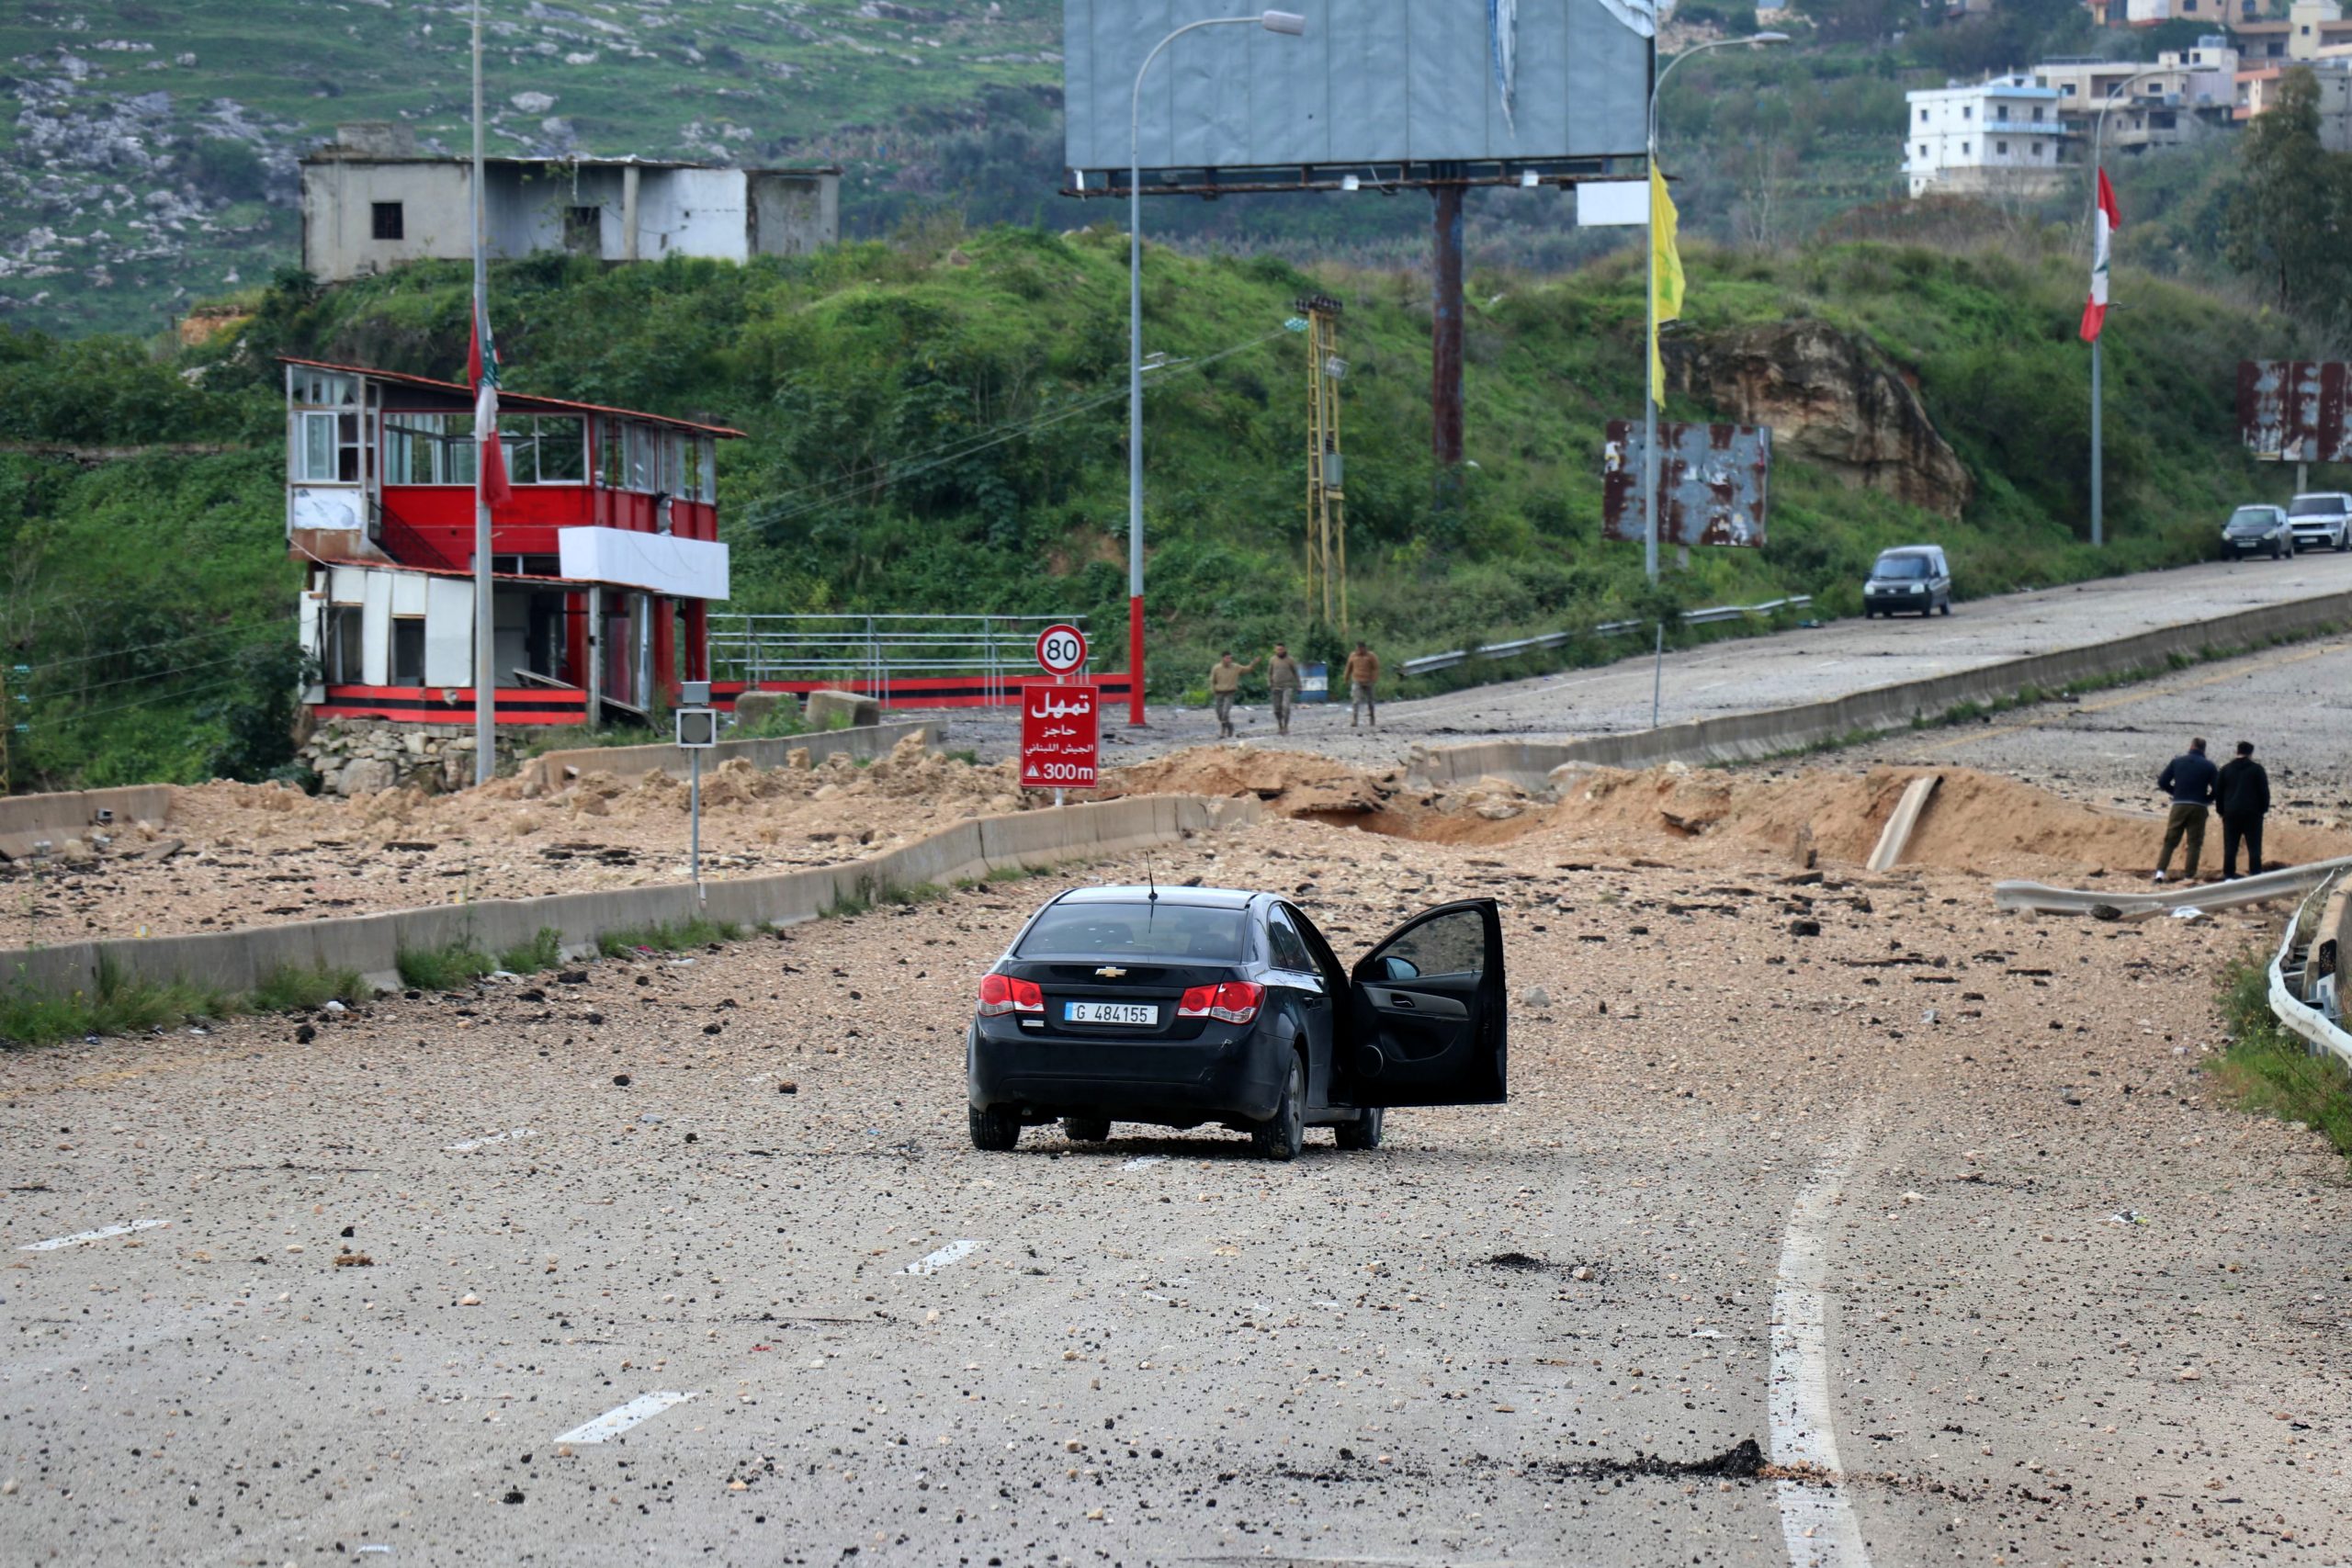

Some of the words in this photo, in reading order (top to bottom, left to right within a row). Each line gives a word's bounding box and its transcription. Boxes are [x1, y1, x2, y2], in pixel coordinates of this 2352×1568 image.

[1046, 639, 1078, 661] 80
[1031, 692, 1091, 718] تمهل
[1042, 725, 1077, 738] حاجز
[1025, 743, 1058, 756] اللبناني
[1060, 744, 1093, 755] الجيش
[1076, 1005, 1086, 1020] G
[1094, 1005, 1148, 1022] 484155
